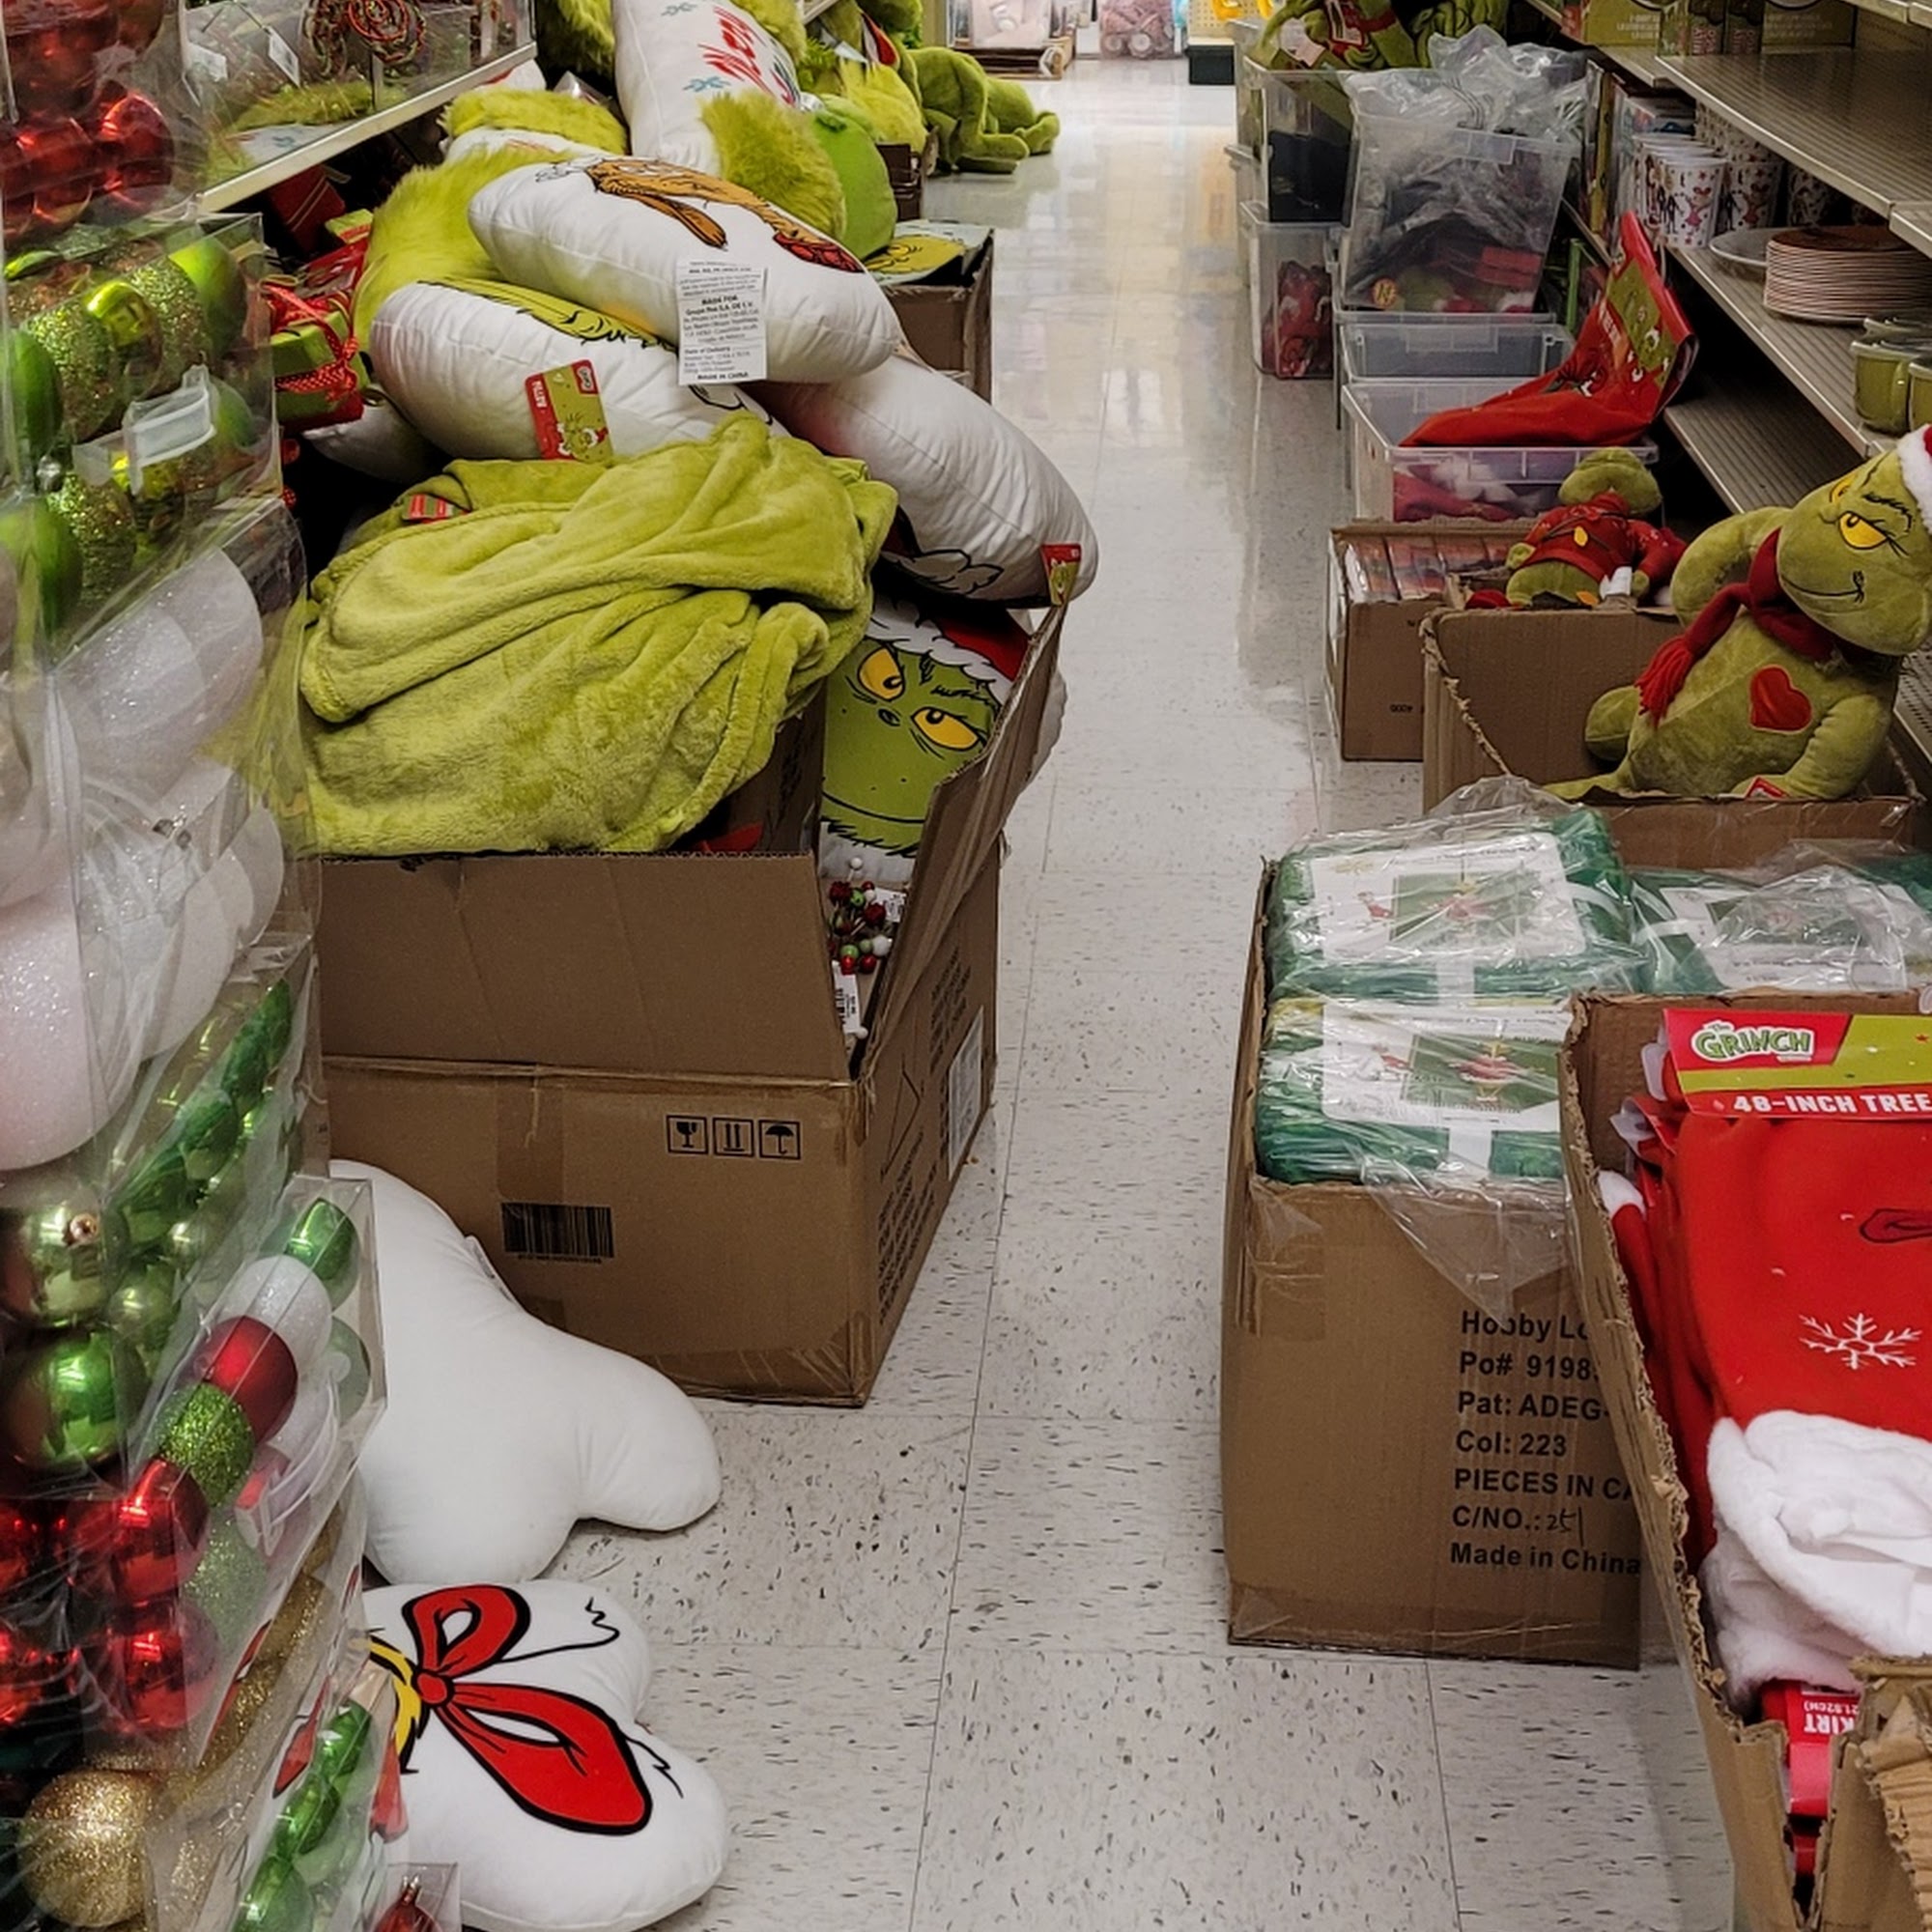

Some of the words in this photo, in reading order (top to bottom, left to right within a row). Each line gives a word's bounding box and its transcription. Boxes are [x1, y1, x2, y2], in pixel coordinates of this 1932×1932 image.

[1694, 1029, 1811, 1059] GRINCH
[1733, 1094, 1858, 1112] 48-INCH
[1860, 1093, 1932, 1112] TREE
[1460, 1350, 1513, 1376] Po#
[1526, 1354, 1599, 1383] 9198
[1458, 1390, 1511, 1415] Pat:
[1456, 1430, 1511, 1454] Col:
[1520, 1433, 1567, 1457] 223
[1455, 1468, 1558, 1494] PIECES
[1567, 1474, 1594, 1497] IN
[1452, 1505, 1540, 1530] C/NO.:
[1450, 1543, 1521, 1566] Made
[1529, 1546, 1553, 1568] in
[1561, 1548, 1641, 1575] China
